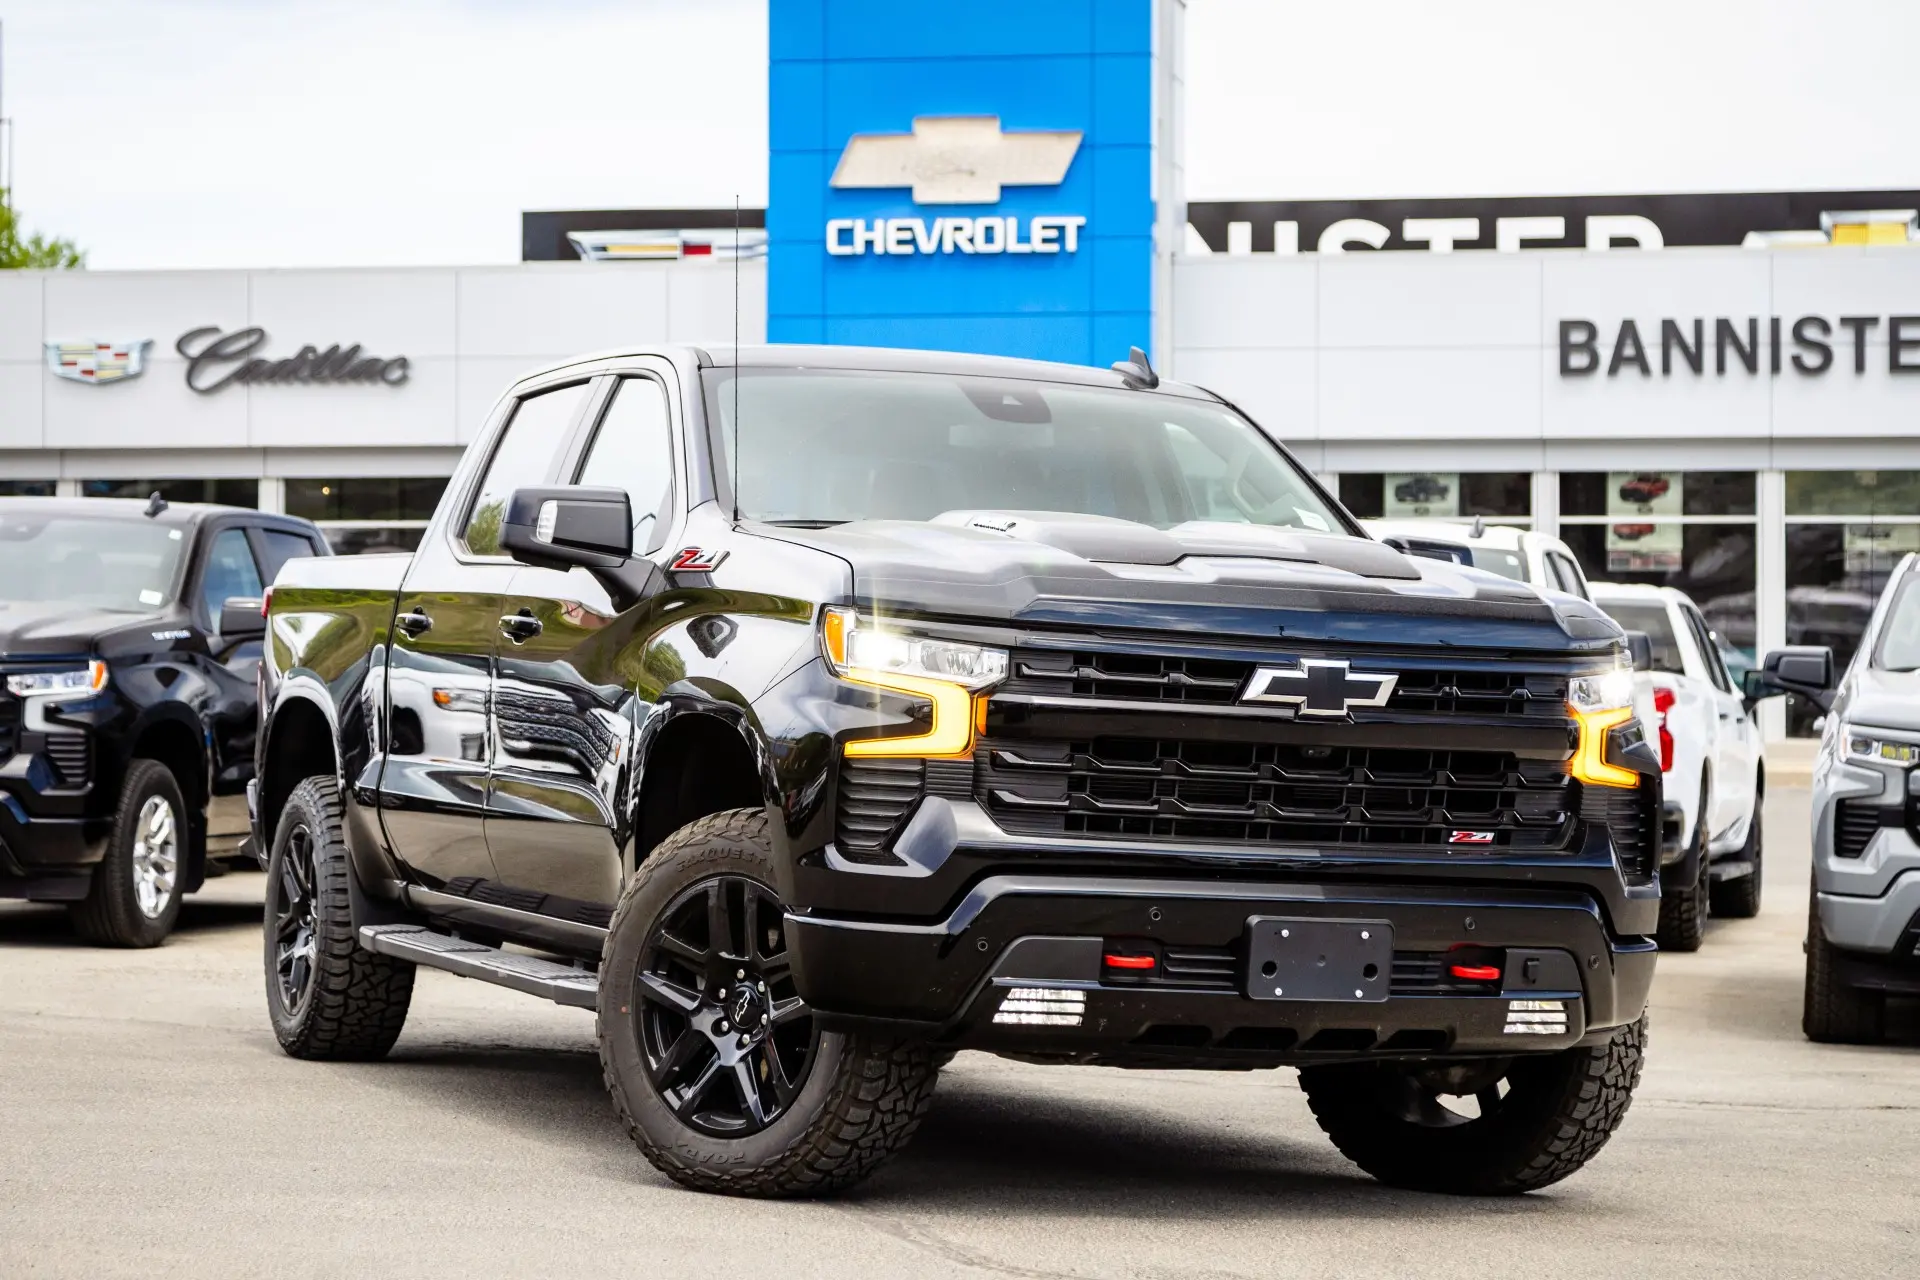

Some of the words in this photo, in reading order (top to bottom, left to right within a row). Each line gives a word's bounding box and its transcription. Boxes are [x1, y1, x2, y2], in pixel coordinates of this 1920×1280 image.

[826, 216, 1087, 256] CHEVROLET
[175, 326, 410, 394] Cadillac
[1558, 316, 1920, 376] BANNISTE
